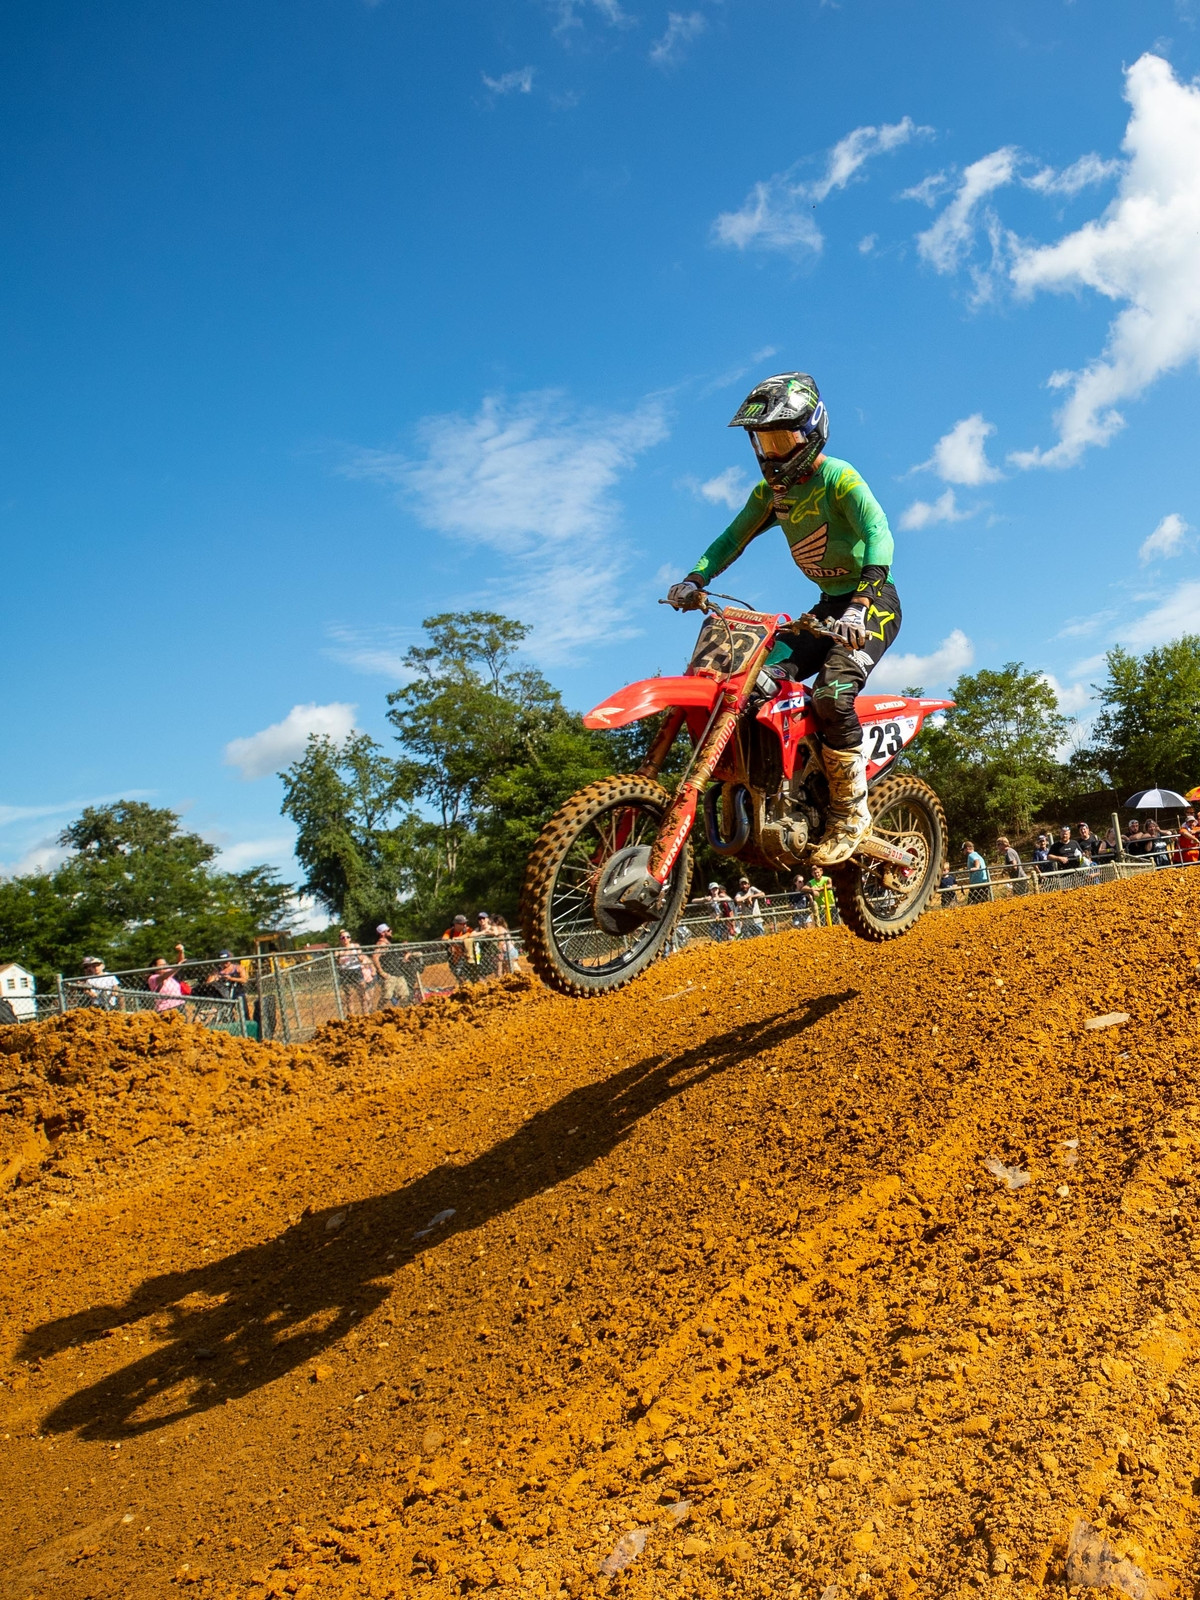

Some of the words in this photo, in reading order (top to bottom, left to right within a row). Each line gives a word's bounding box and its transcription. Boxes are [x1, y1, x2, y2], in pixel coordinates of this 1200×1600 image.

[802, 567, 850, 577] ONDA
[693, 628, 755, 674] 23
[708, 716, 736, 772] SHOWA
[869, 722, 903, 760] 23
[660, 814, 692, 879] DUNLOP
